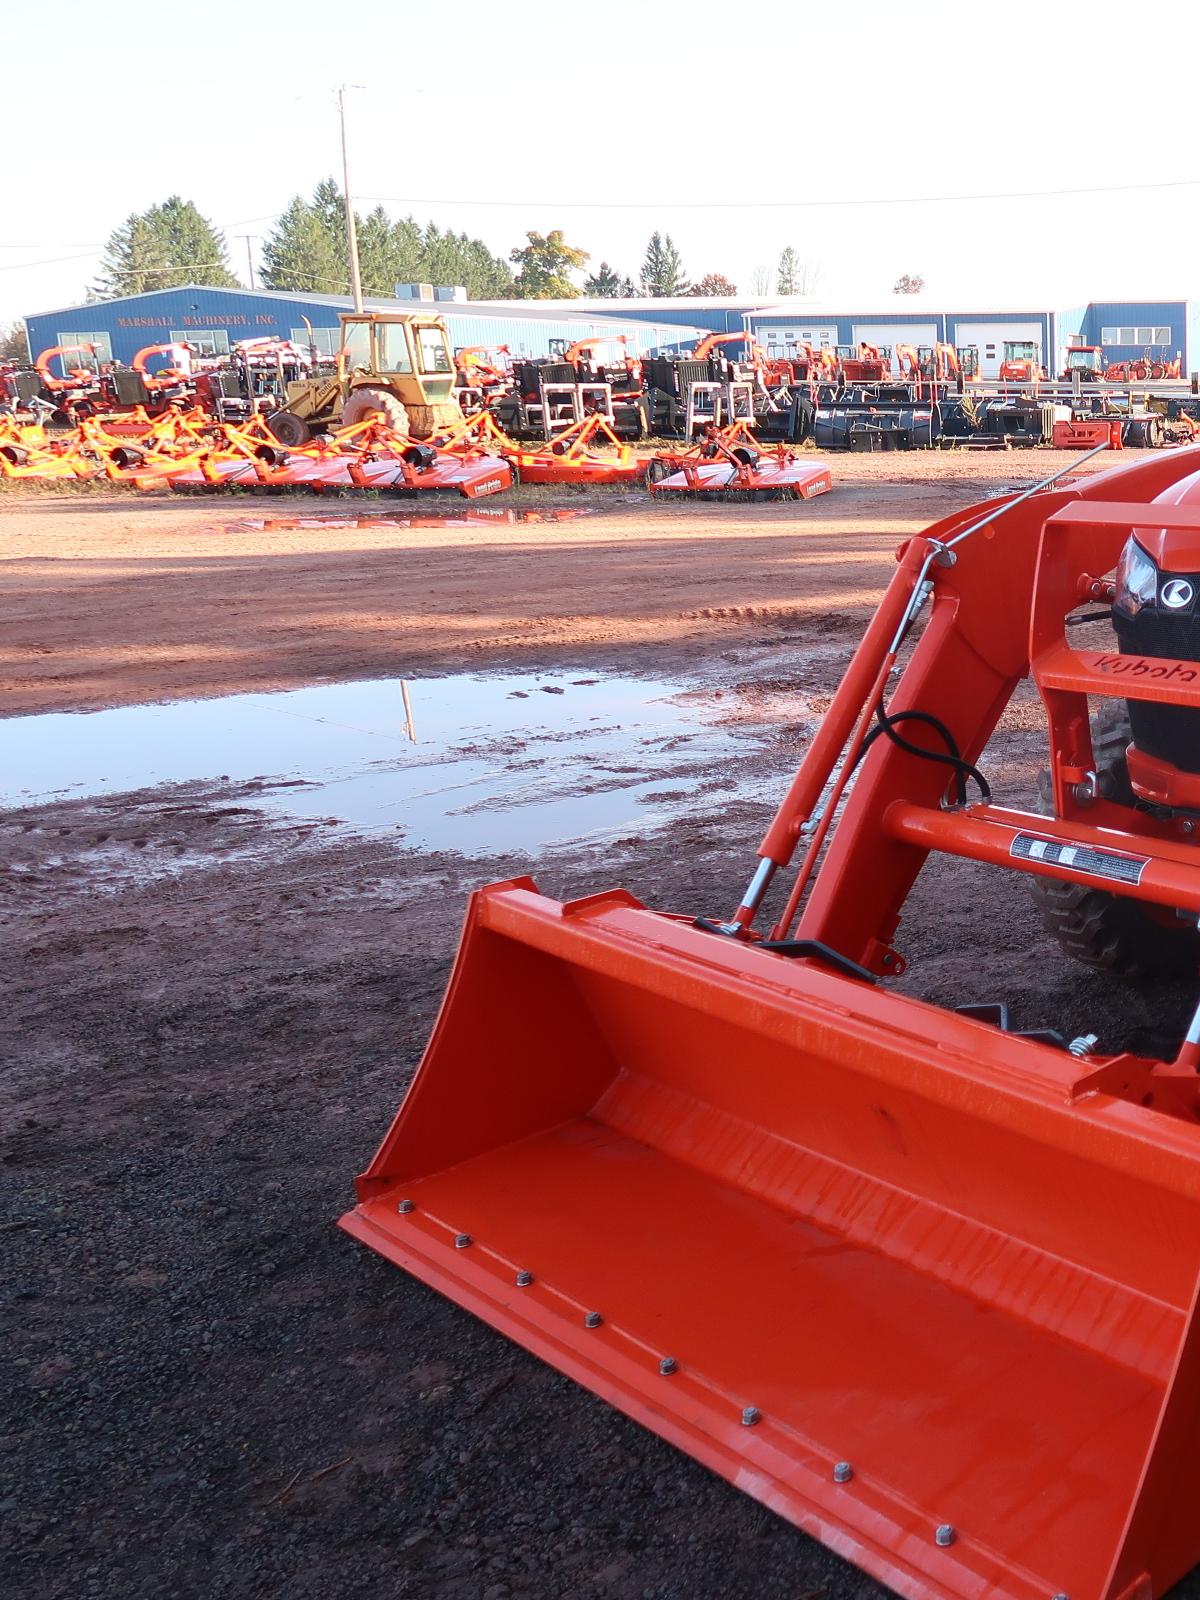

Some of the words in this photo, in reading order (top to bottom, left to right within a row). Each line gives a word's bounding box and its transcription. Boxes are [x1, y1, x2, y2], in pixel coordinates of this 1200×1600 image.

[118, 316, 176, 328] MARSHALL
[182, 315, 251, 325] MACHINERY,
[255, 314, 278, 325] INC.
[318, 382, 333, 398] FORD
[1093, 656, 1197, 682] Kubota
